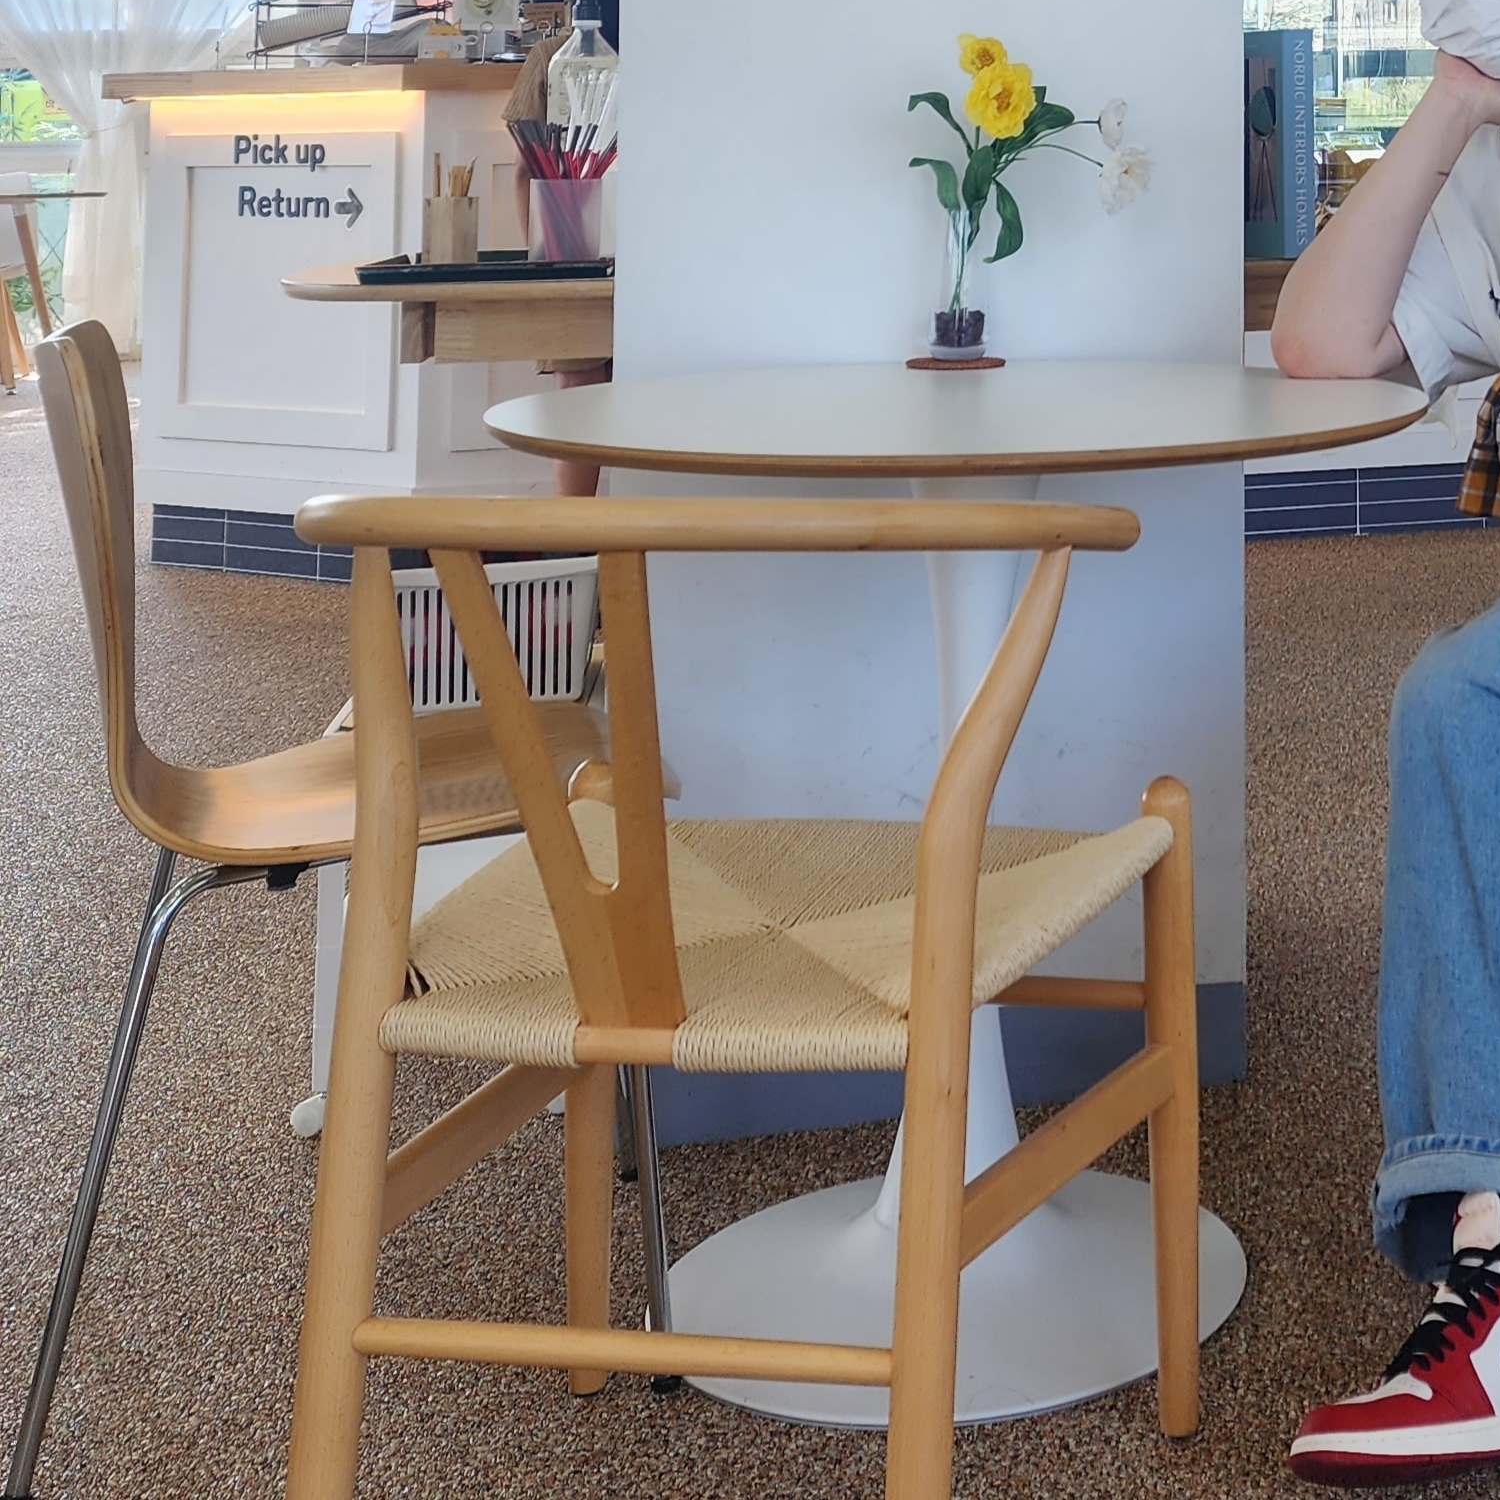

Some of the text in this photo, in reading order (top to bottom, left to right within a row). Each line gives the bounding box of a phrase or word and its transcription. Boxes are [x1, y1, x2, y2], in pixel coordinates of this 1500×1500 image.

[233, 134, 326, 173] Pick up
[1293, 39, 1308, 246] NORDIC INTERIORS HOMES
[237, 185, 330, 219] Return
